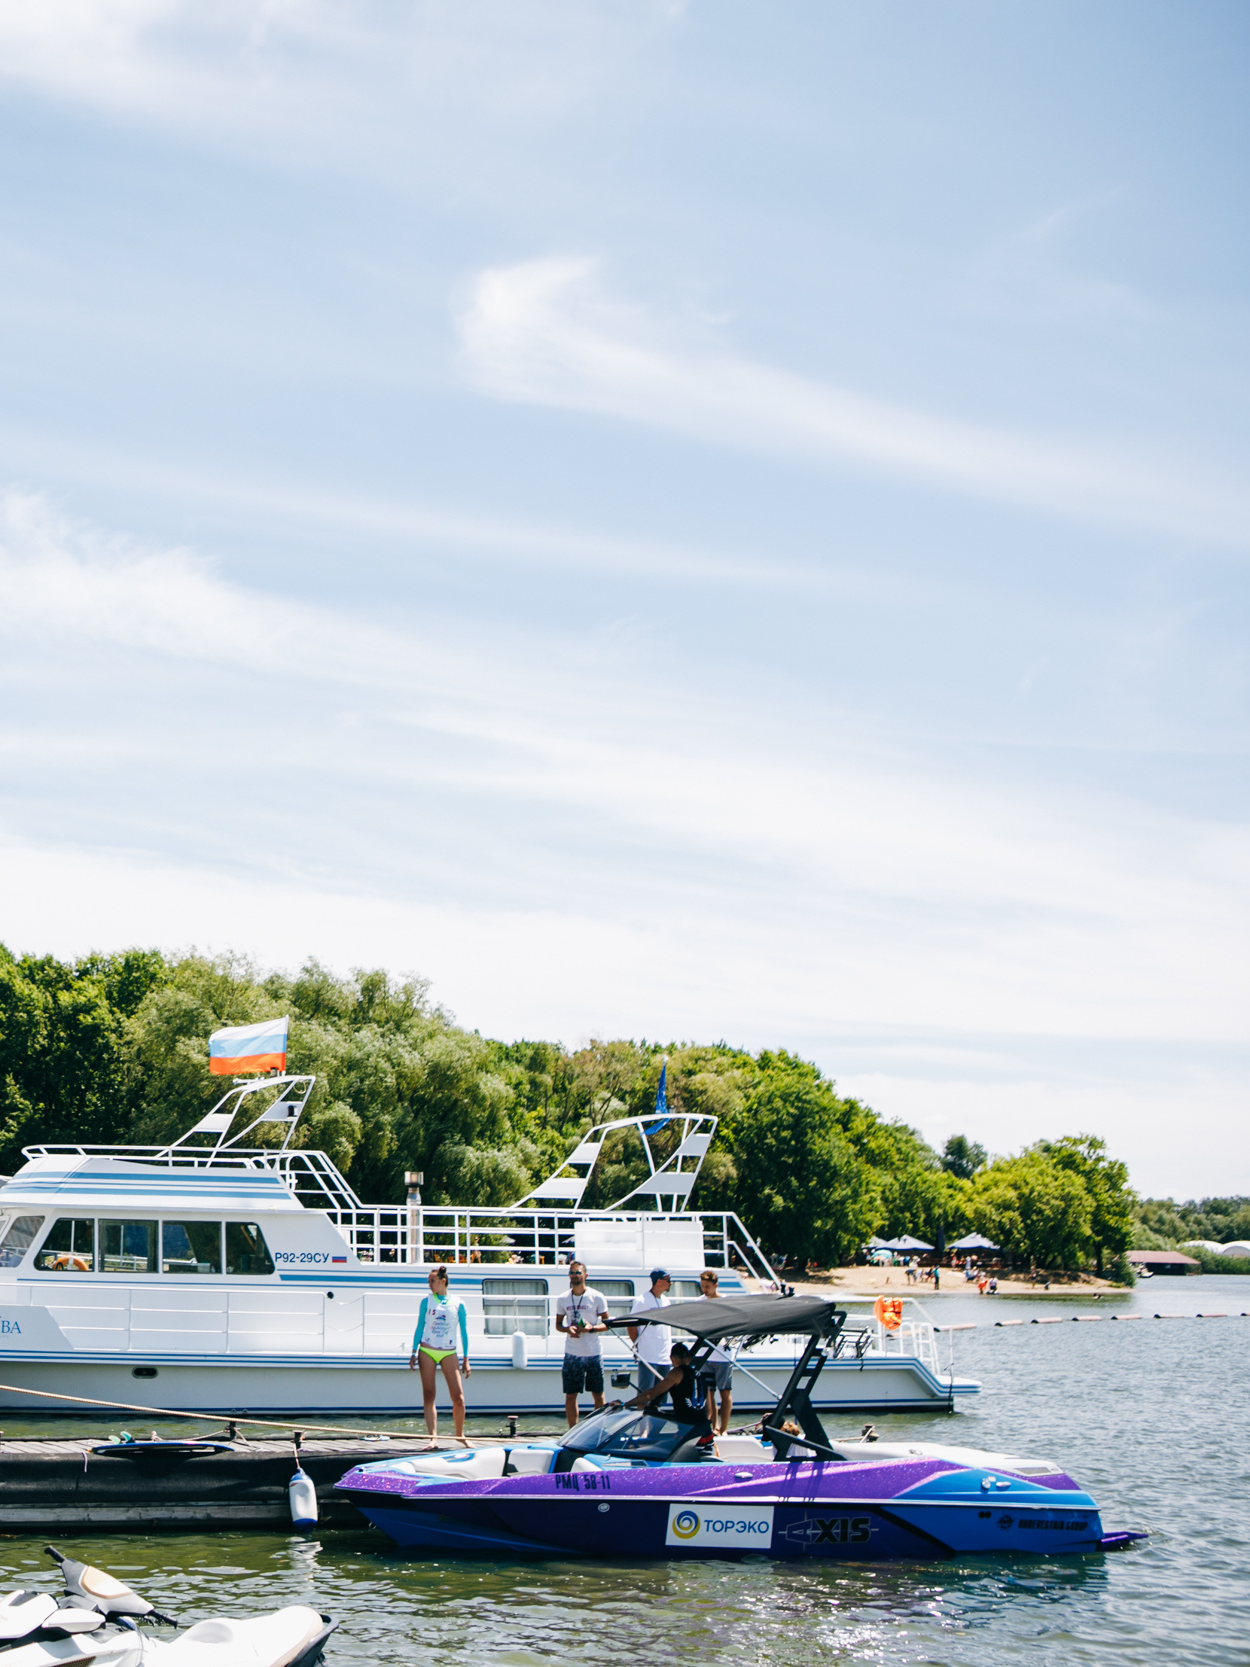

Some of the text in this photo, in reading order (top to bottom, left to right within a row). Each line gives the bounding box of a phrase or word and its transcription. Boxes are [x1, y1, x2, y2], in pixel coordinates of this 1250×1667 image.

[555, 1474, 610, 1492] РМЦ 58-11
[703, 1519, 770, 1534] ТОРЭКО
